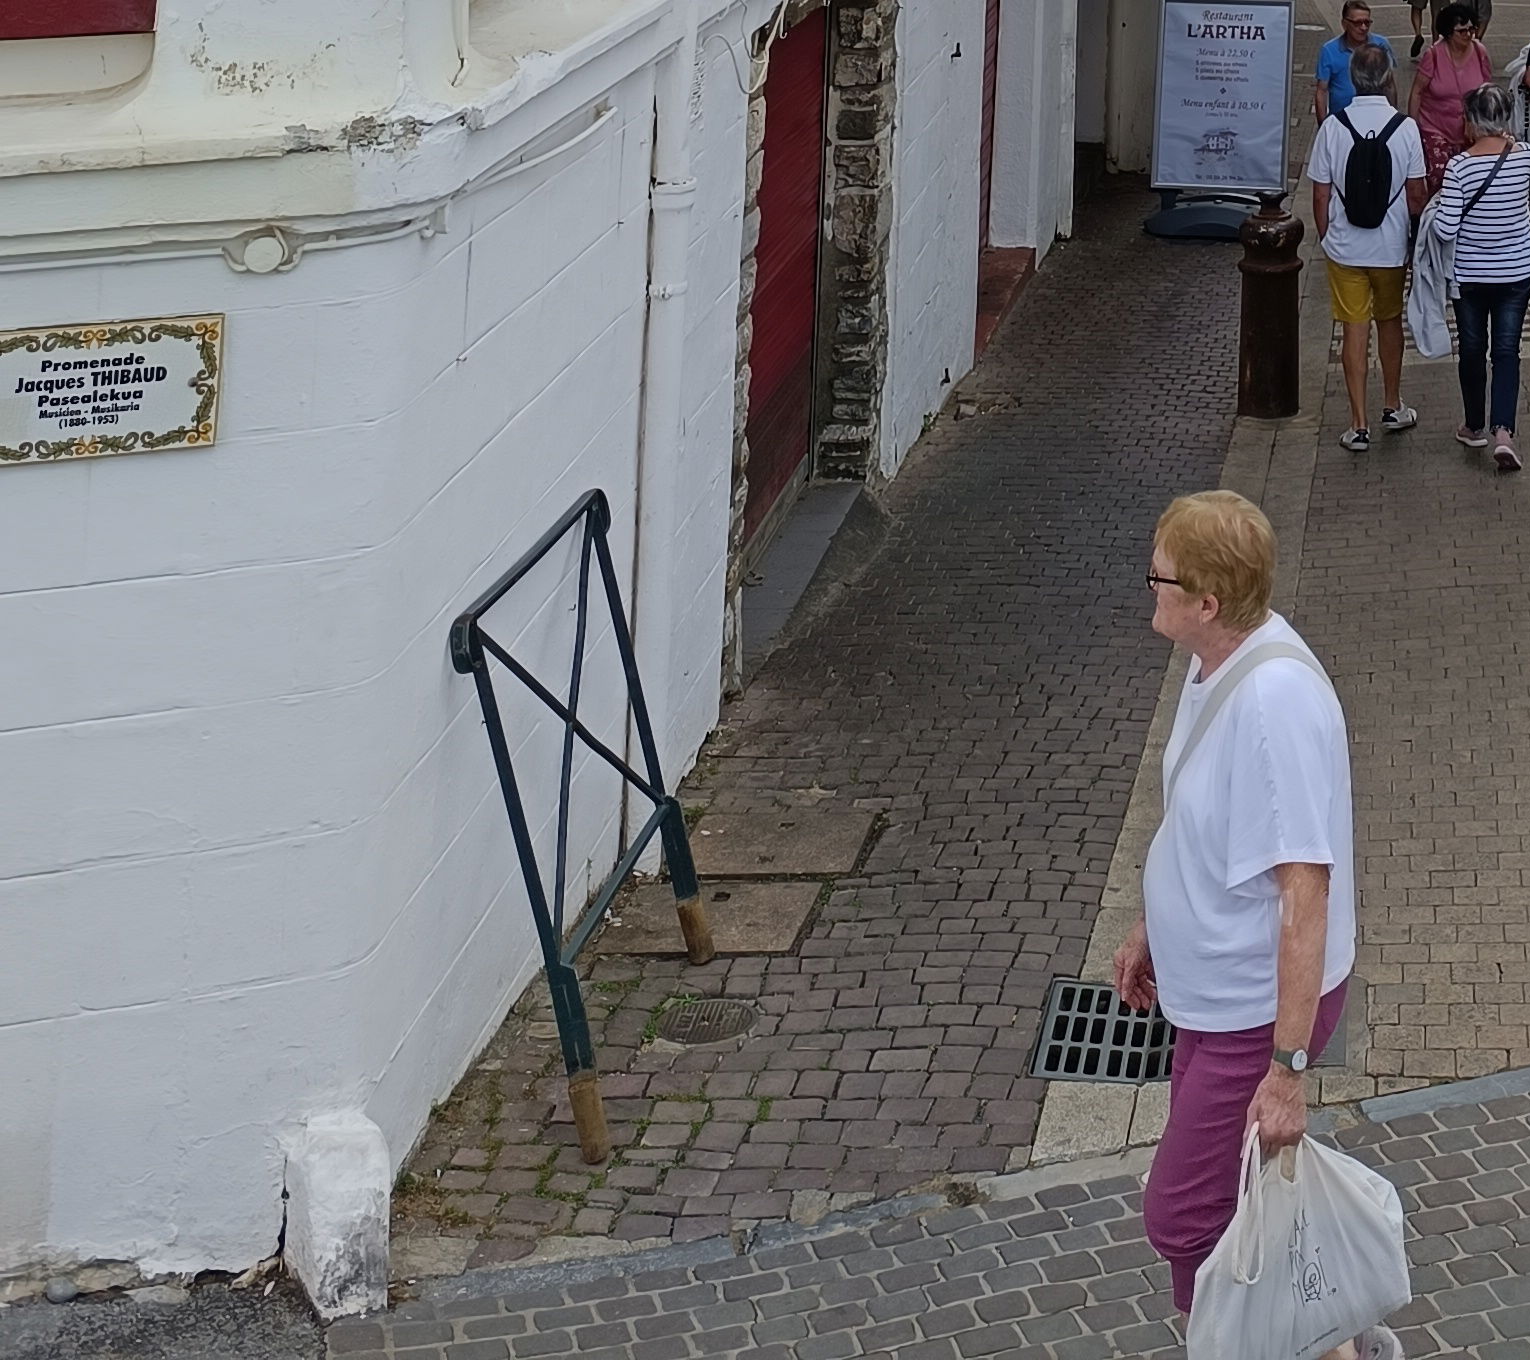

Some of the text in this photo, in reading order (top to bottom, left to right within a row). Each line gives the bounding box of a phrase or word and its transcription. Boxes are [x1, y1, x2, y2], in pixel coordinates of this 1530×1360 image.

[1202, 10, 1254, 22] Restaurant
[1187, 23, 1266, 40] L'ARTHA
[1196, 47, 1219, 57] Menu
[1180, 98, 1203, 108] Menu
[1204, 99, 1230, 110] enfant
[1231, 100, 1236, 109] à
[1238, 101, 1259, 111] 10,50
[41, 353, 146, 373] Promenade
[15, 366, 168, 394] Jacques THIBAUD
[37, 388, 144, 408] Pasealekua
[39, 407, 82, 419] Musicien
[91, 403, 140, 415] Musikaria
[58, 414, 119, 429] (1880-1953)
